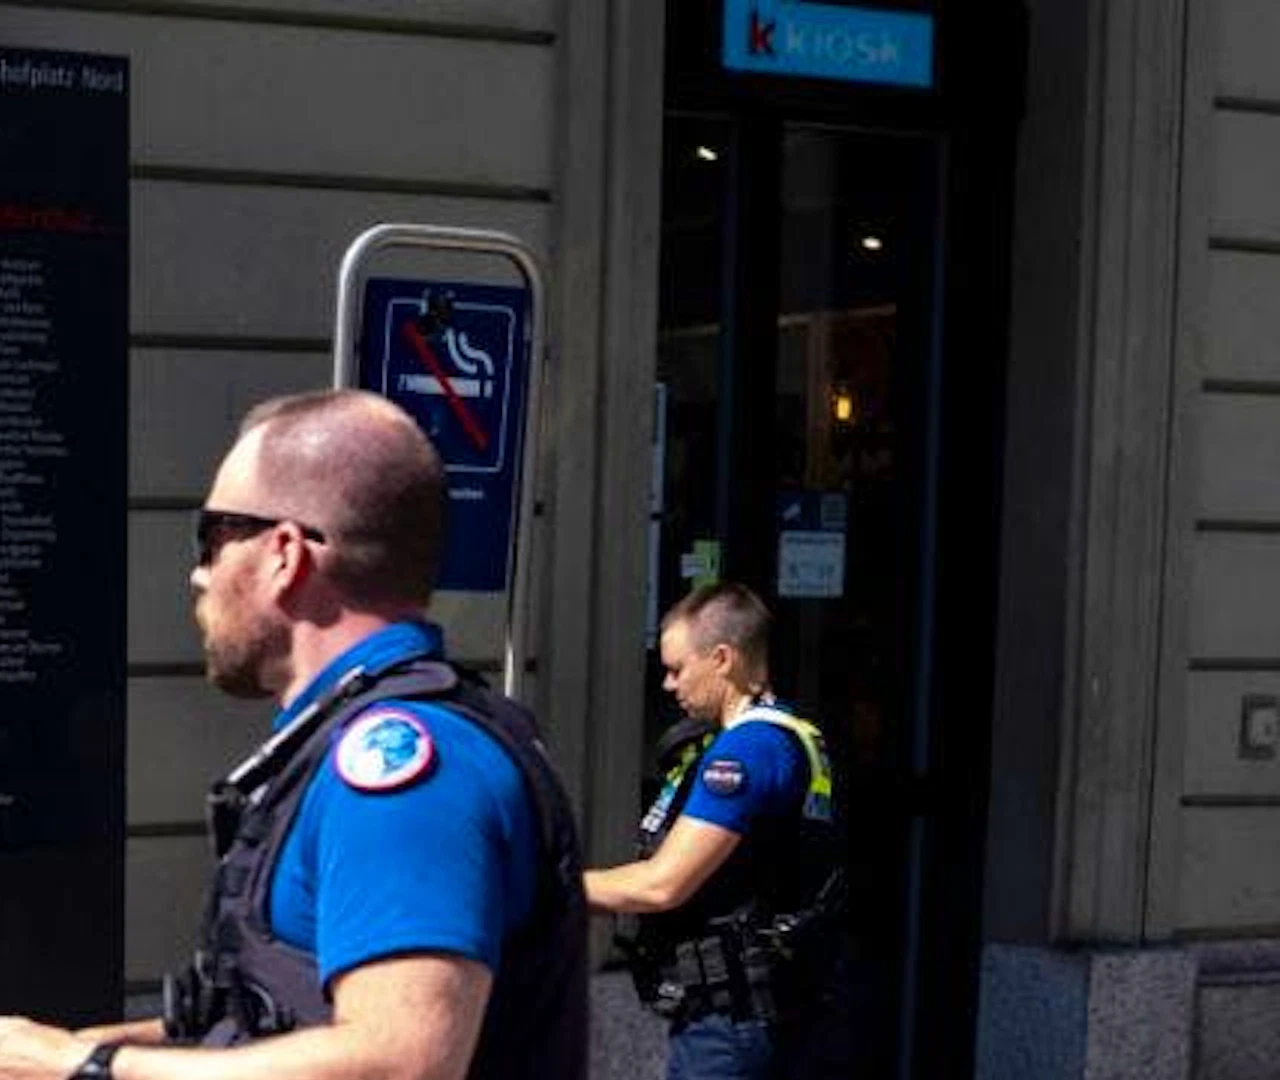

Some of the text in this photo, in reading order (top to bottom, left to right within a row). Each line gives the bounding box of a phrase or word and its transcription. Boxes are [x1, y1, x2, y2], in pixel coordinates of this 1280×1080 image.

[750, 12, 900, 65] k kiosk
[81, 64, 125, 94] Nord
